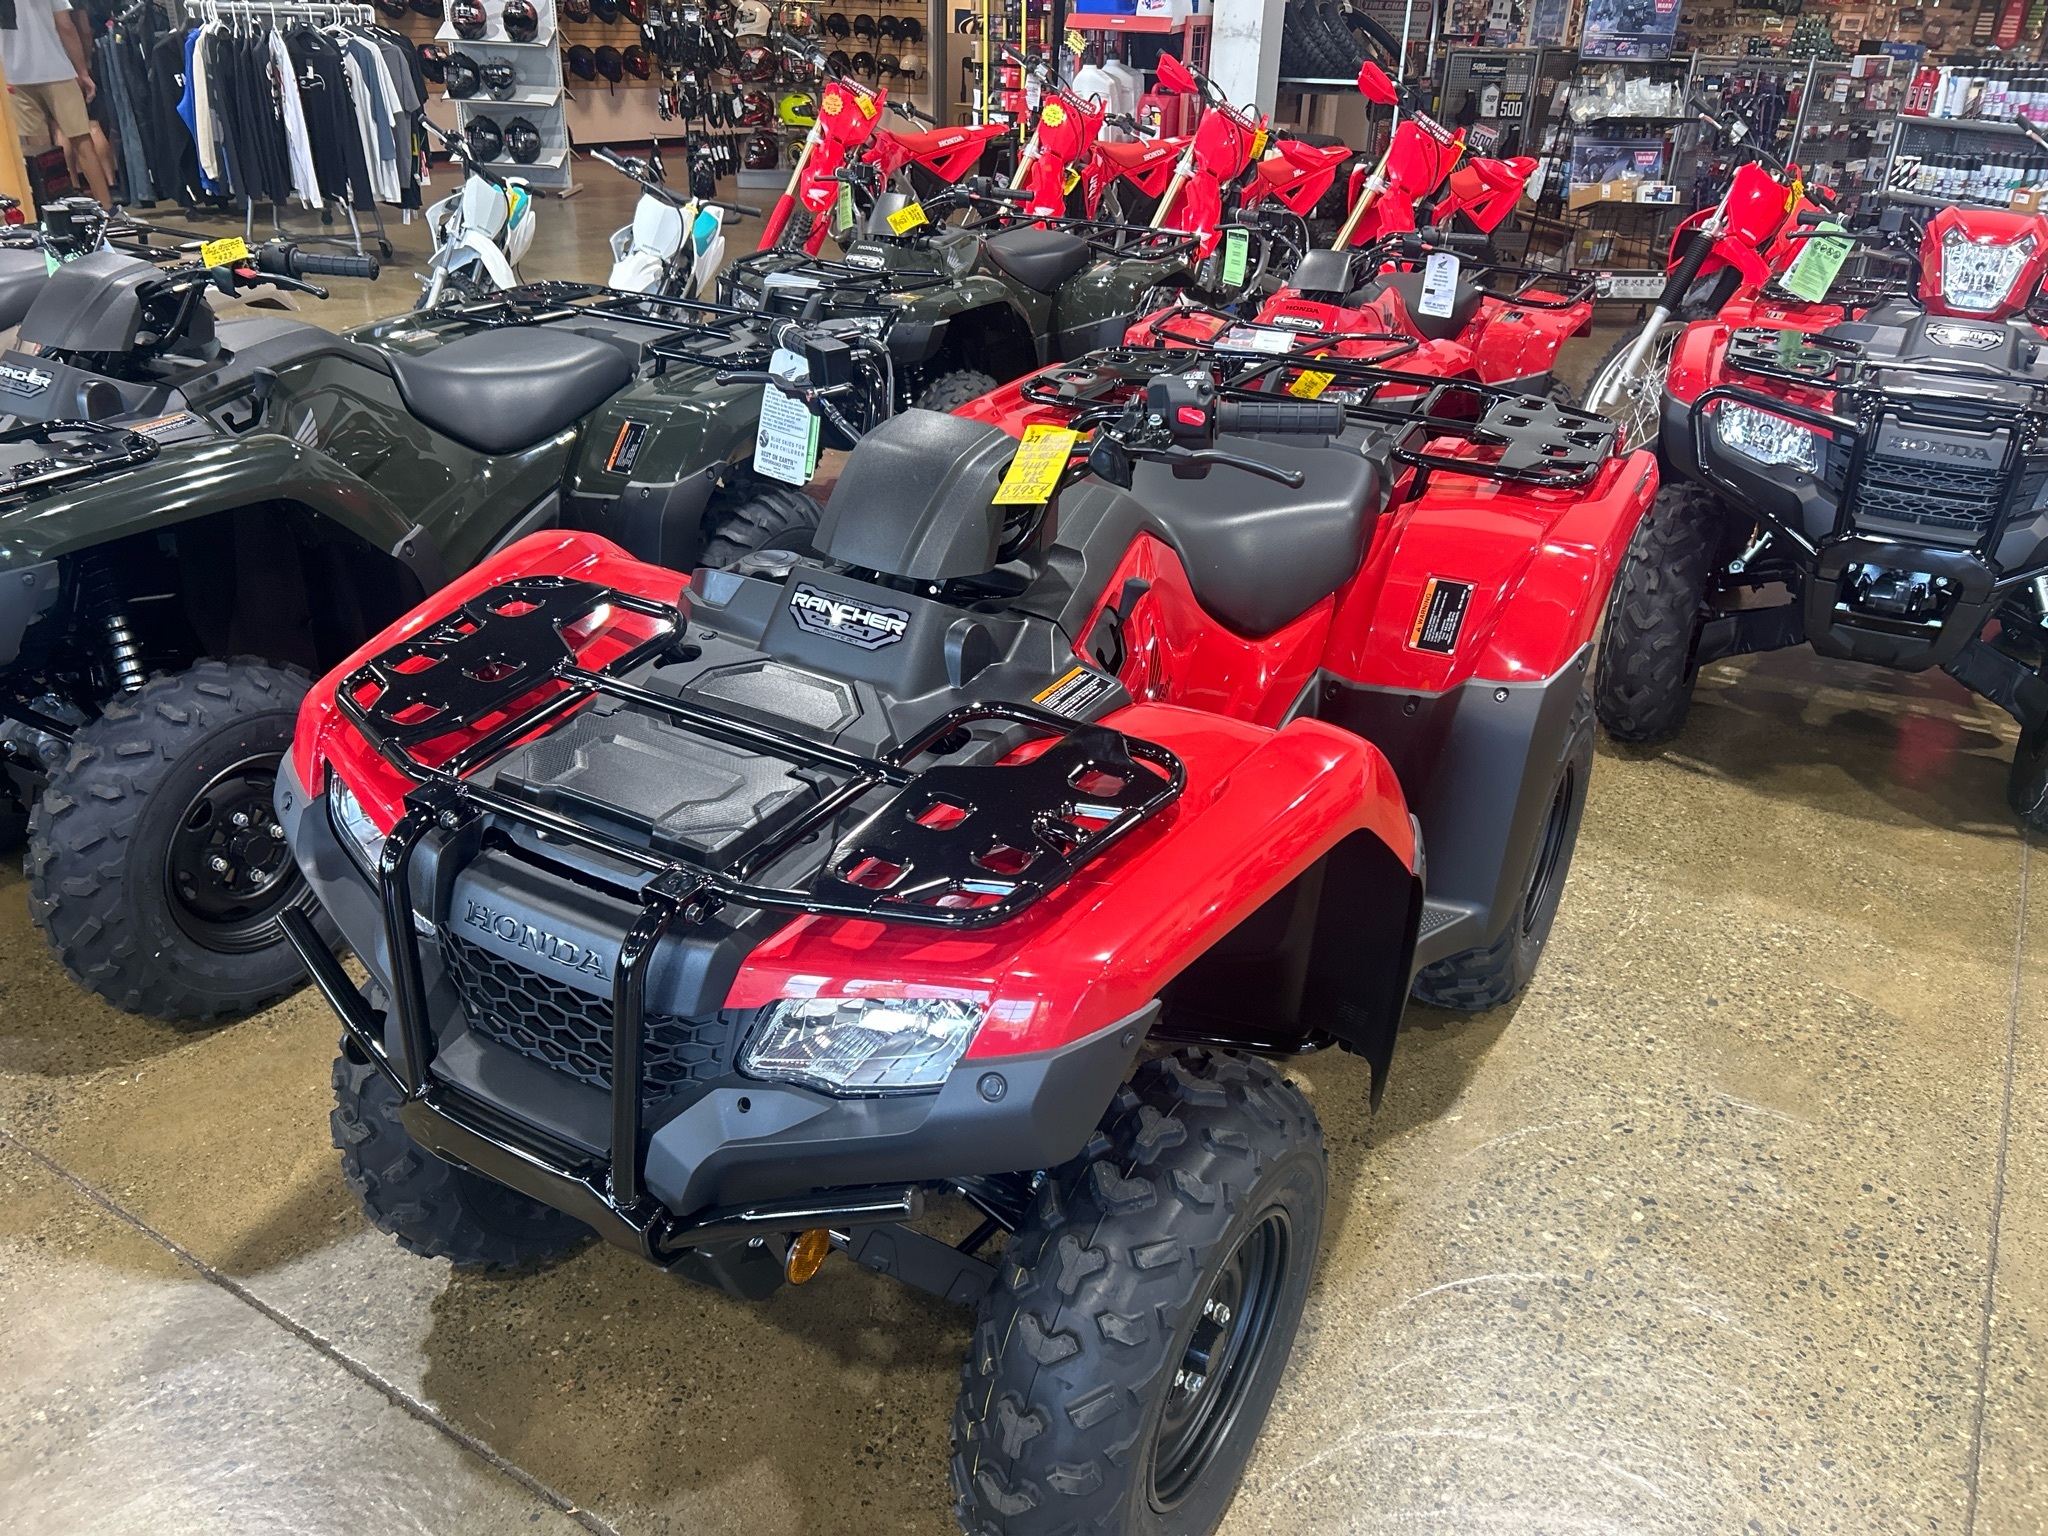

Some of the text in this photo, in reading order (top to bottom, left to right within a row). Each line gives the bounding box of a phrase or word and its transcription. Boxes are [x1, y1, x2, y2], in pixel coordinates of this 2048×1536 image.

[1364, 1, 1430, 11] TIRE CHAGES
[1500, 101, 1523, 117] 500
[1421, 114, 1452, 139] RENTHAL
[938, 135, 964, 148] HONDA
[1143, 149, 1166, 161] HONDA
[857, 245, 884, 254] HONDA
[1285, 304, 1320, 315] HONDA
[1272, 315, 1325, 330] RECON
[1925, 327, 2004, 343] FOMAN
[1887, 435, 1993, 462] HONDA
[791, 591, 907, 636] RANCHER
[1417, 593, 1432, 625] WARNING
[464, 899, 612, 983] HONDA
